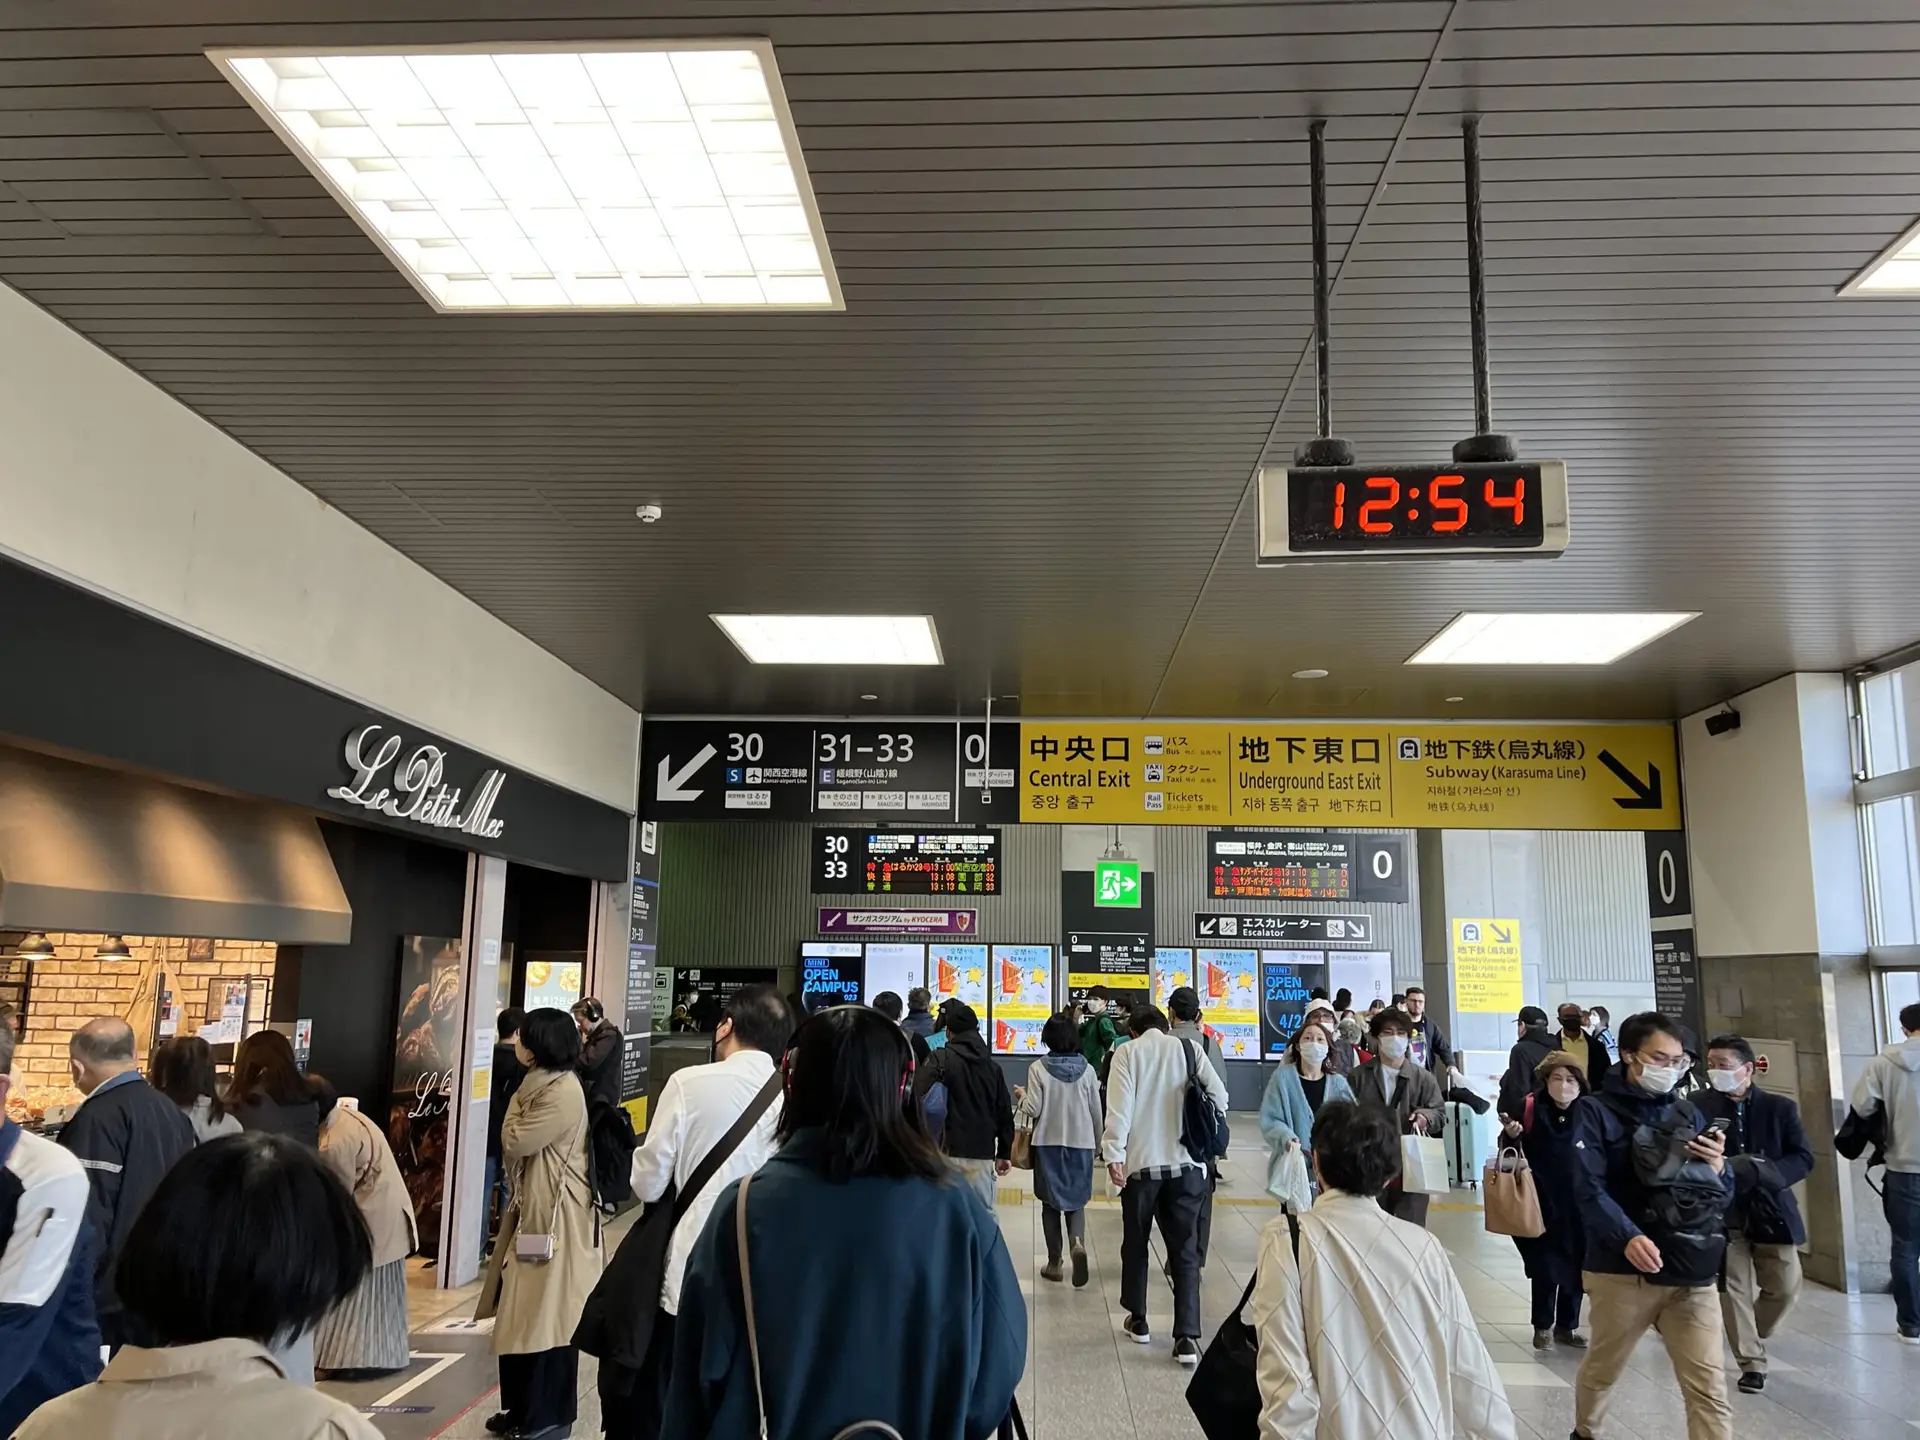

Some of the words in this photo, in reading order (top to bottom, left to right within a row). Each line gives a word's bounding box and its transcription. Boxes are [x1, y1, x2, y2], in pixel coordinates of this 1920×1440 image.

[1333, 475, 1525, 533] 12:54
[726, 732, 765, 762] 30
[1166, 736, 1189, 746] バス
[819, 733, 914, 763] 31-33
[965, 734, 985, 763] 0
[1030, 735, 1130, 762] 中央口
[1166, 747, 1180, 755] Bus
[1238, 736, 1380, 764] 地下東口
[1425, 739, 1585, 760] 地下鉄(烏丸線)
[823, 769, 832, 782] E
[978, 771, 1013, 779] サダーバード
[1167, 764, 1210, 774] タクシー
[334, 725, 402, 810] Le
[395, 745, 462, 828] Petit
[456, 770, 506, 838] Mec
[730, 769, 739, 783] S
[1029, 769, 1092, 787] Central
[1097, 769, 1131, 788] Exit
[1167, 775, 1182, 783] Taxi
[1239, 770, 1324, 794] Underground
[1327, 772, 1354, 790] East
[1357, 772, 1381, 790] Exit
[1031, 794, 1060, 809] 중앙
[1065, 794, 1095, 810] 출구
[1166, 792, 1204, 802] Tickets
[1146, 801, 1163, 809] Pass
[1242, 797, 1266, 812] 지하
[1269, 797, 1293, 812] 동쪽
[1296, 797, 1320, 812] 출구
[1328, 799, 1381, 813] 地下东口
[824, 836, 849, 854] 30
[824, 861, 848, 879] 33
[1372, 850, 1393, 879] 0
[986, 873, 995, 882] 32
[1658, 849, 1676, 904] 0
[986, 882, 995, 892] 33
[852, 915, 903, 924] サンガスタジアム
[903, 917, 910, 925] by
[1242, 918, 1321, 930] エスカレーター
[1071, 935, 1078, 944] 0
[1242, 928, 1285, 938] Escalator
[807, 959, 827, 967] MINI
[804, 969, 839, 980] OPEN
[803, 981, 859, 993] CAMPUS
[1265, 976, 1302, 988] OPEN
[1265, 989, 1313, 1001] CAMPU
